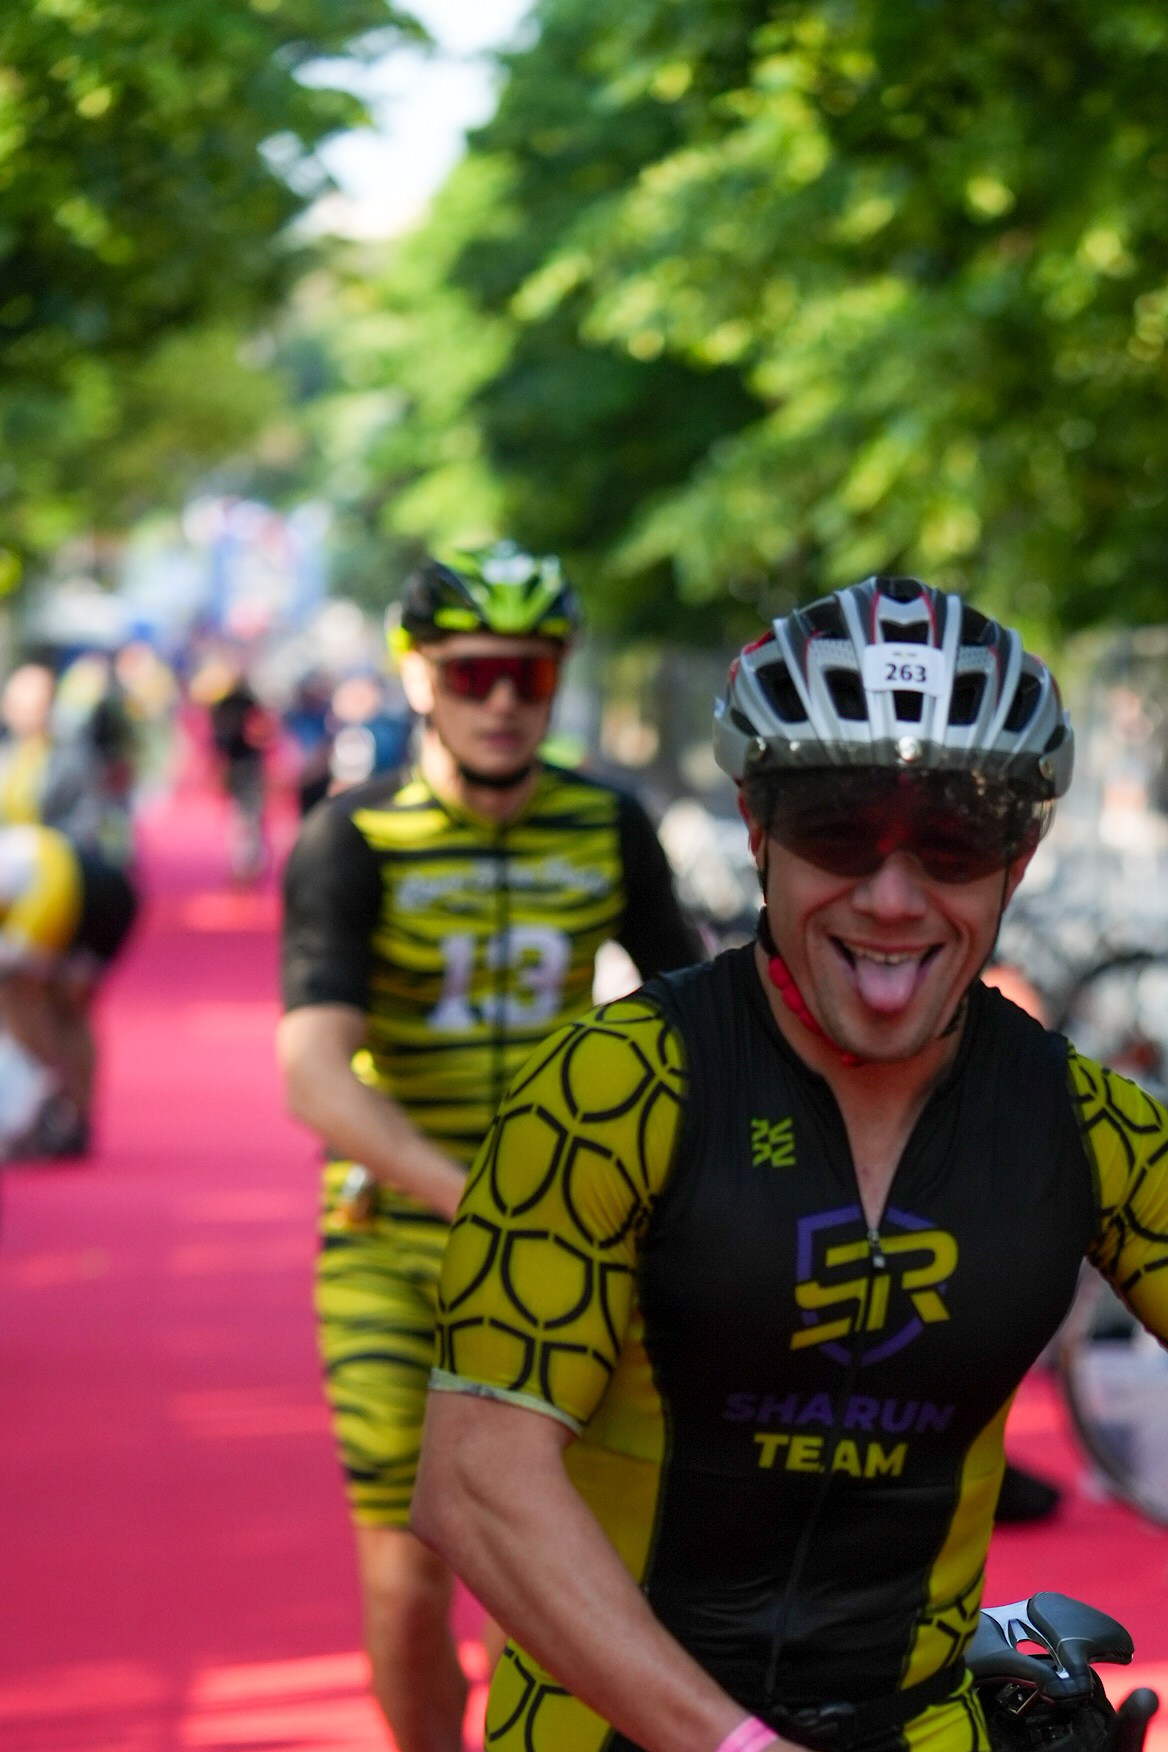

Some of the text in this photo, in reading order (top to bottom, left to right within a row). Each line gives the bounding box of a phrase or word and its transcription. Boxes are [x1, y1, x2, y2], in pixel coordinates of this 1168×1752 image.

[885, 663, 927, 682] 263
[426, 924, 571, 1034] 13
[722, 1392, 956, 1432] SHARUN
[753, 1432, 909, 1478] TEAM
